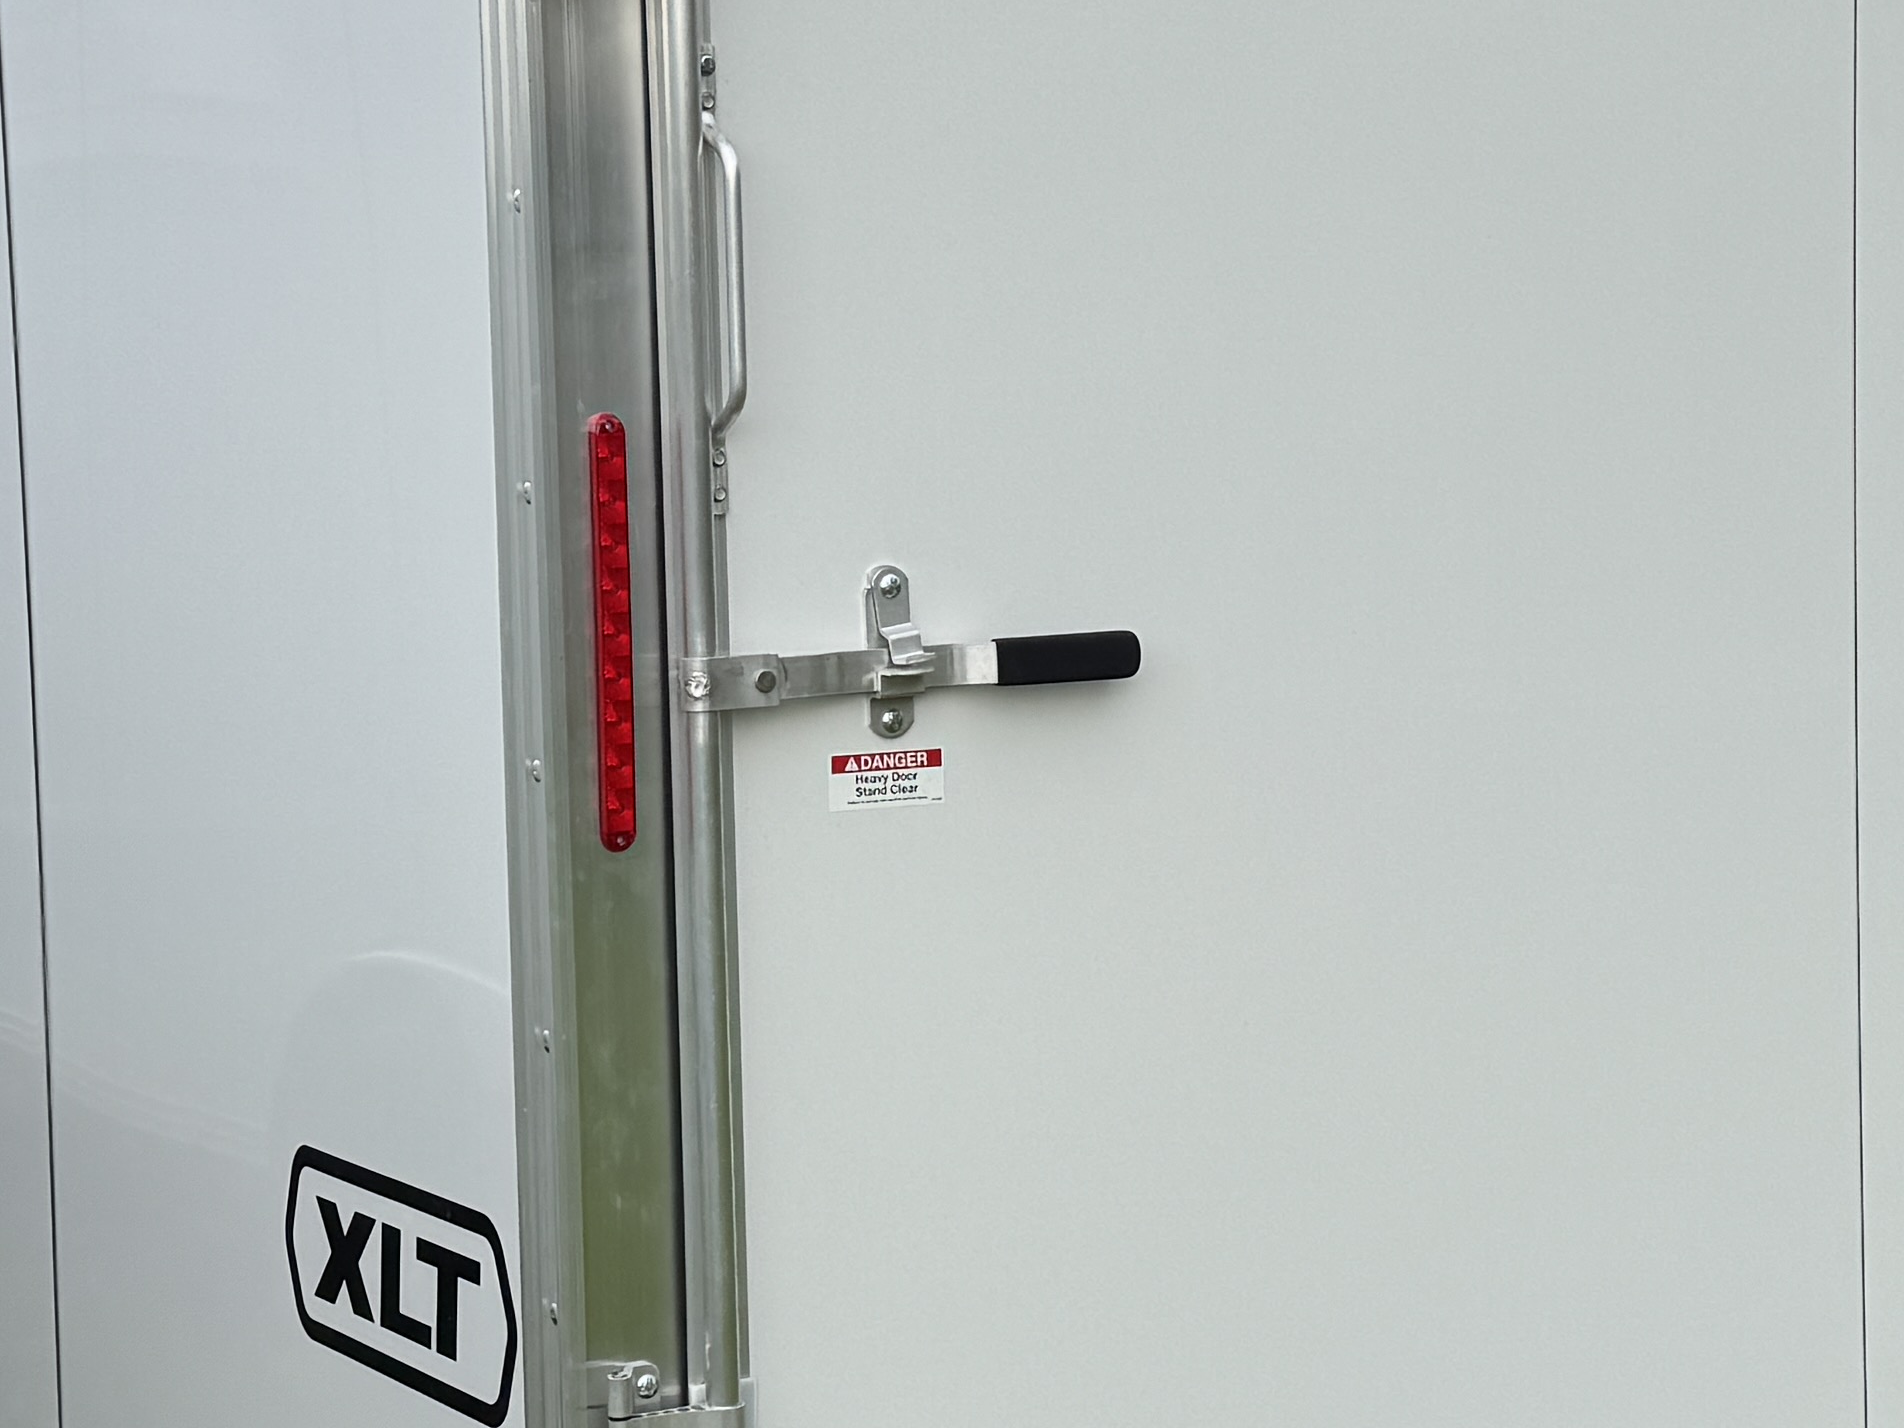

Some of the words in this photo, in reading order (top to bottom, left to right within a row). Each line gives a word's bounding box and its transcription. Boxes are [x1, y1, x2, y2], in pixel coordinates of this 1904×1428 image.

[860, 751, 928, 770] DANGER
[855, 774, 889, 785] Heavy
[891, 772, 918, 782] Door
[855, 785, 887, 798] Stand
[890, 783, 919, 795] Clear
[314, 1195, 481, 1362] XLT
